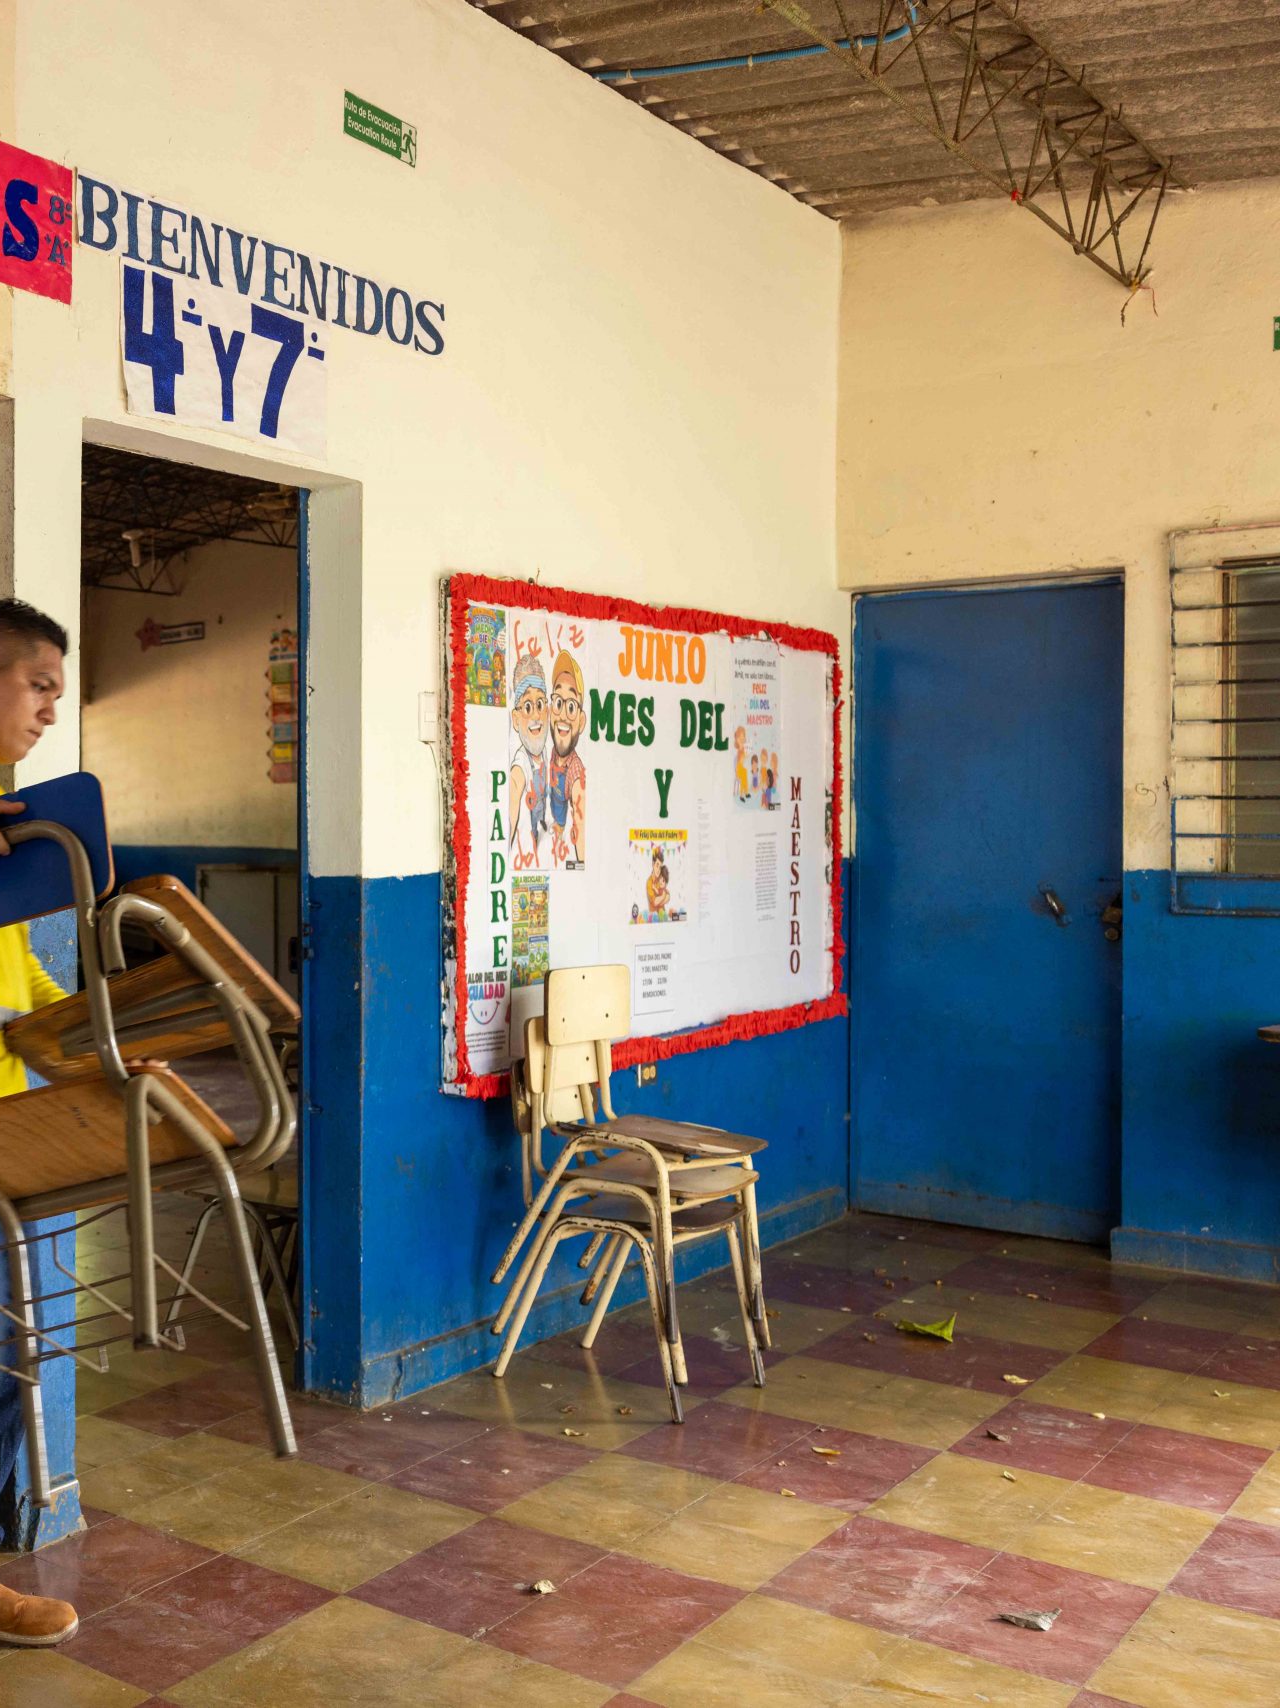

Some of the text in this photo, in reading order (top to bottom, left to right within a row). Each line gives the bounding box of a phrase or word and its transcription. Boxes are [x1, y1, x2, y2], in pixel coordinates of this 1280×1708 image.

[344, 97, 401, 137] Ruta de Evacuación
[347, 115, 397, 150] Evacuation Route
[78, 173, 446, 356] BIENVENIDOS
[207, 324, 246, 422] Y
[618, 626, 706, 685] JUNIO
[589, 688, 729, 751] MES DEL
[654, 768, 674, 819] Y
[490, 770, 509, 968] PADRE
[789, 776, 802, 975] MAESTRO
[467, 971, 508, 984] ALOR DEL MES
[469, 983, 506, 1001] GUALDAD
